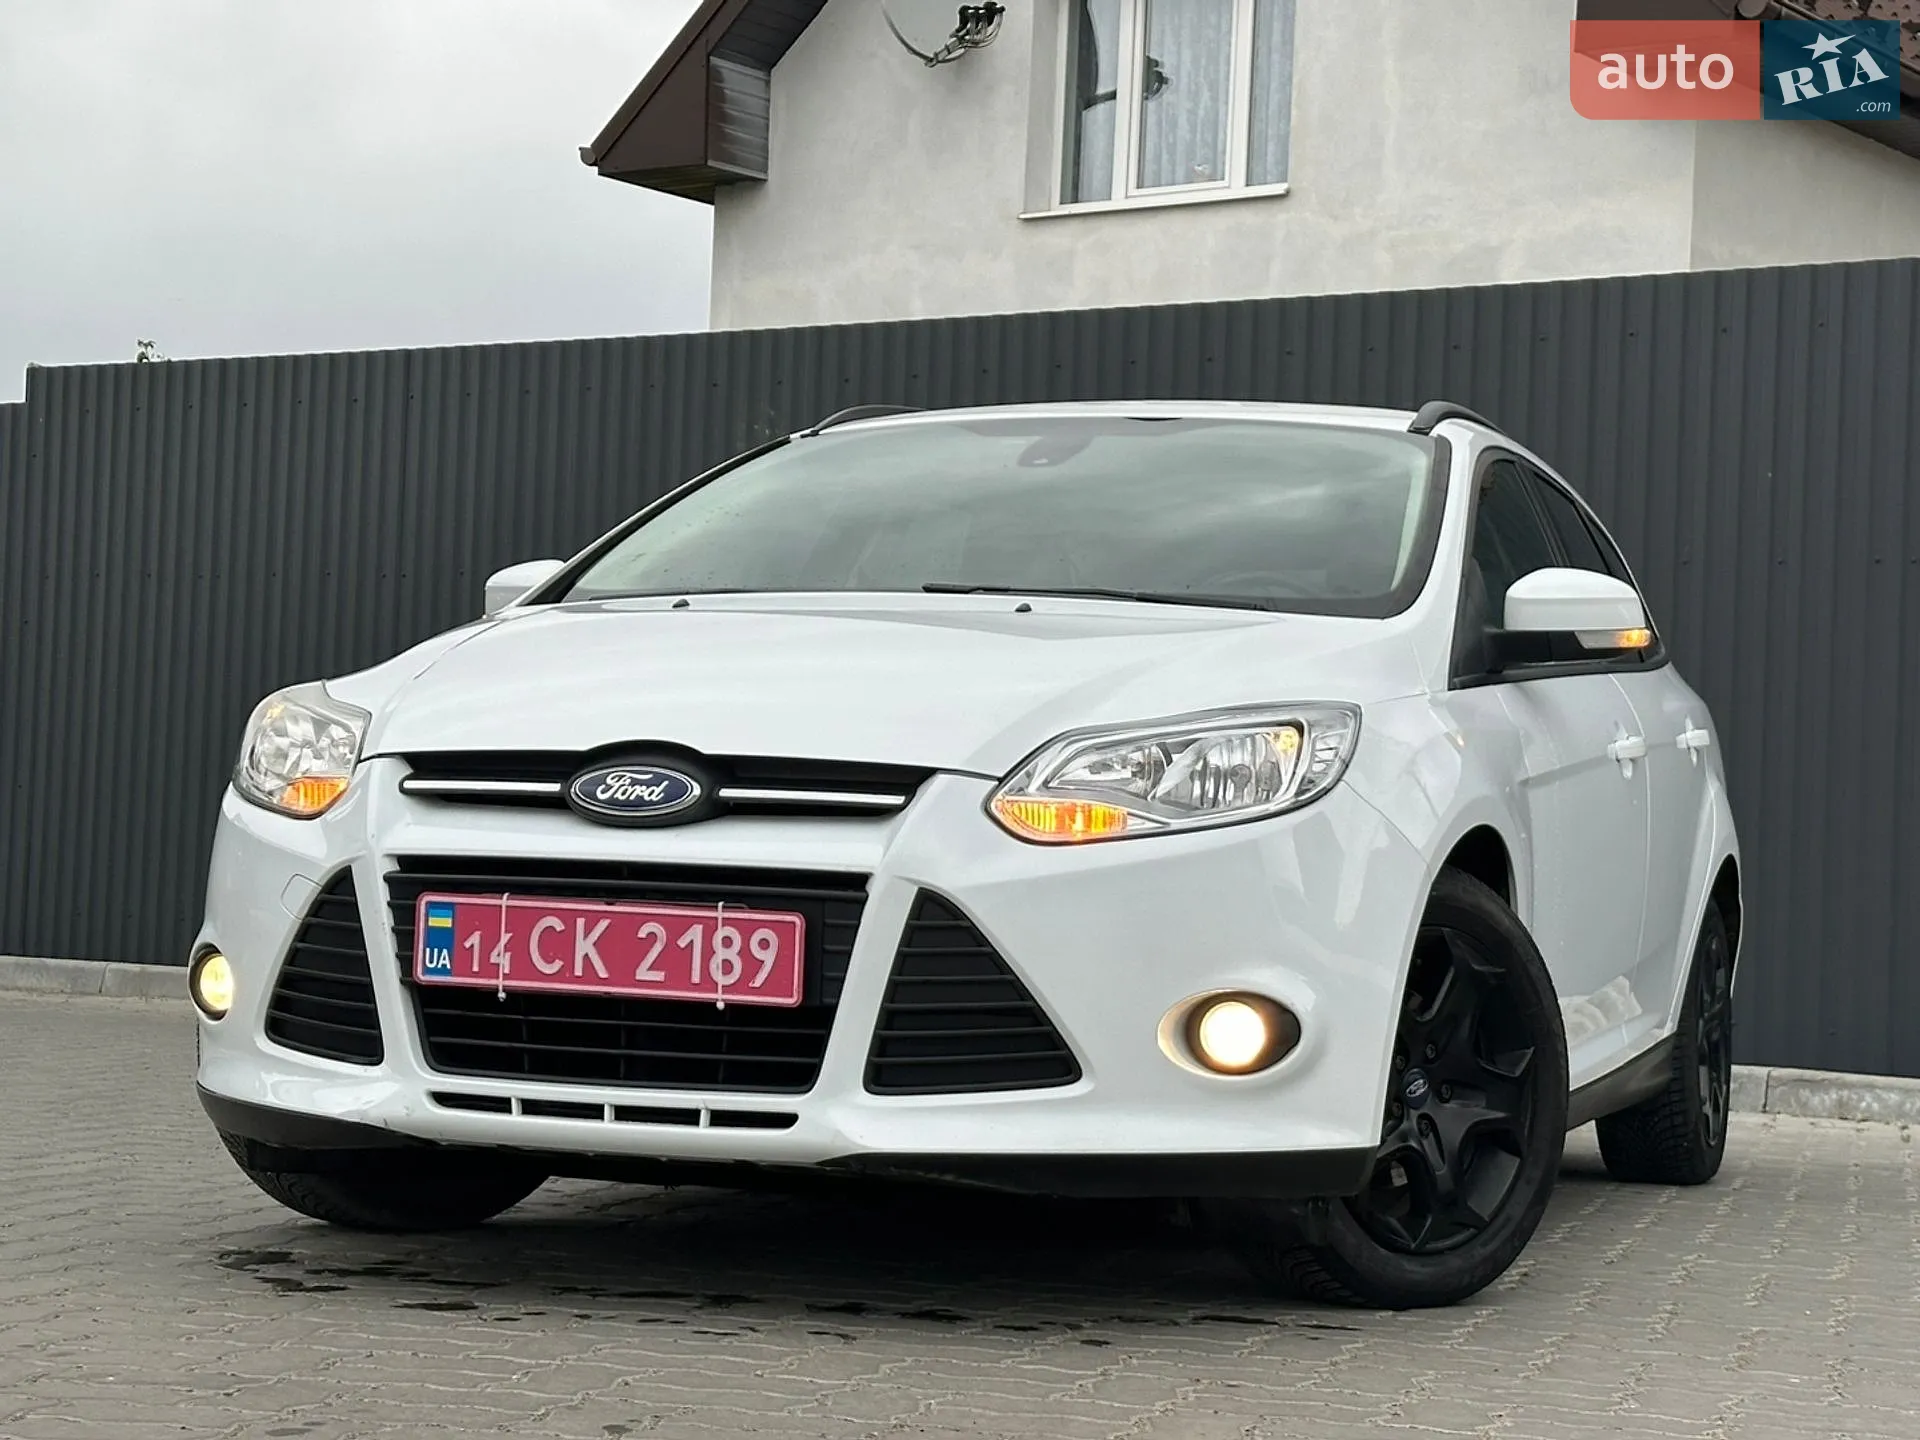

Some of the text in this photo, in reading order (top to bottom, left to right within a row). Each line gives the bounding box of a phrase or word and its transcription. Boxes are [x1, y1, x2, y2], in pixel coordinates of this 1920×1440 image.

[596, 771, 669, 801] Ford
[425, 948, 451, 969] UA
[462, 915, 779, 988] 14 CK 2189
